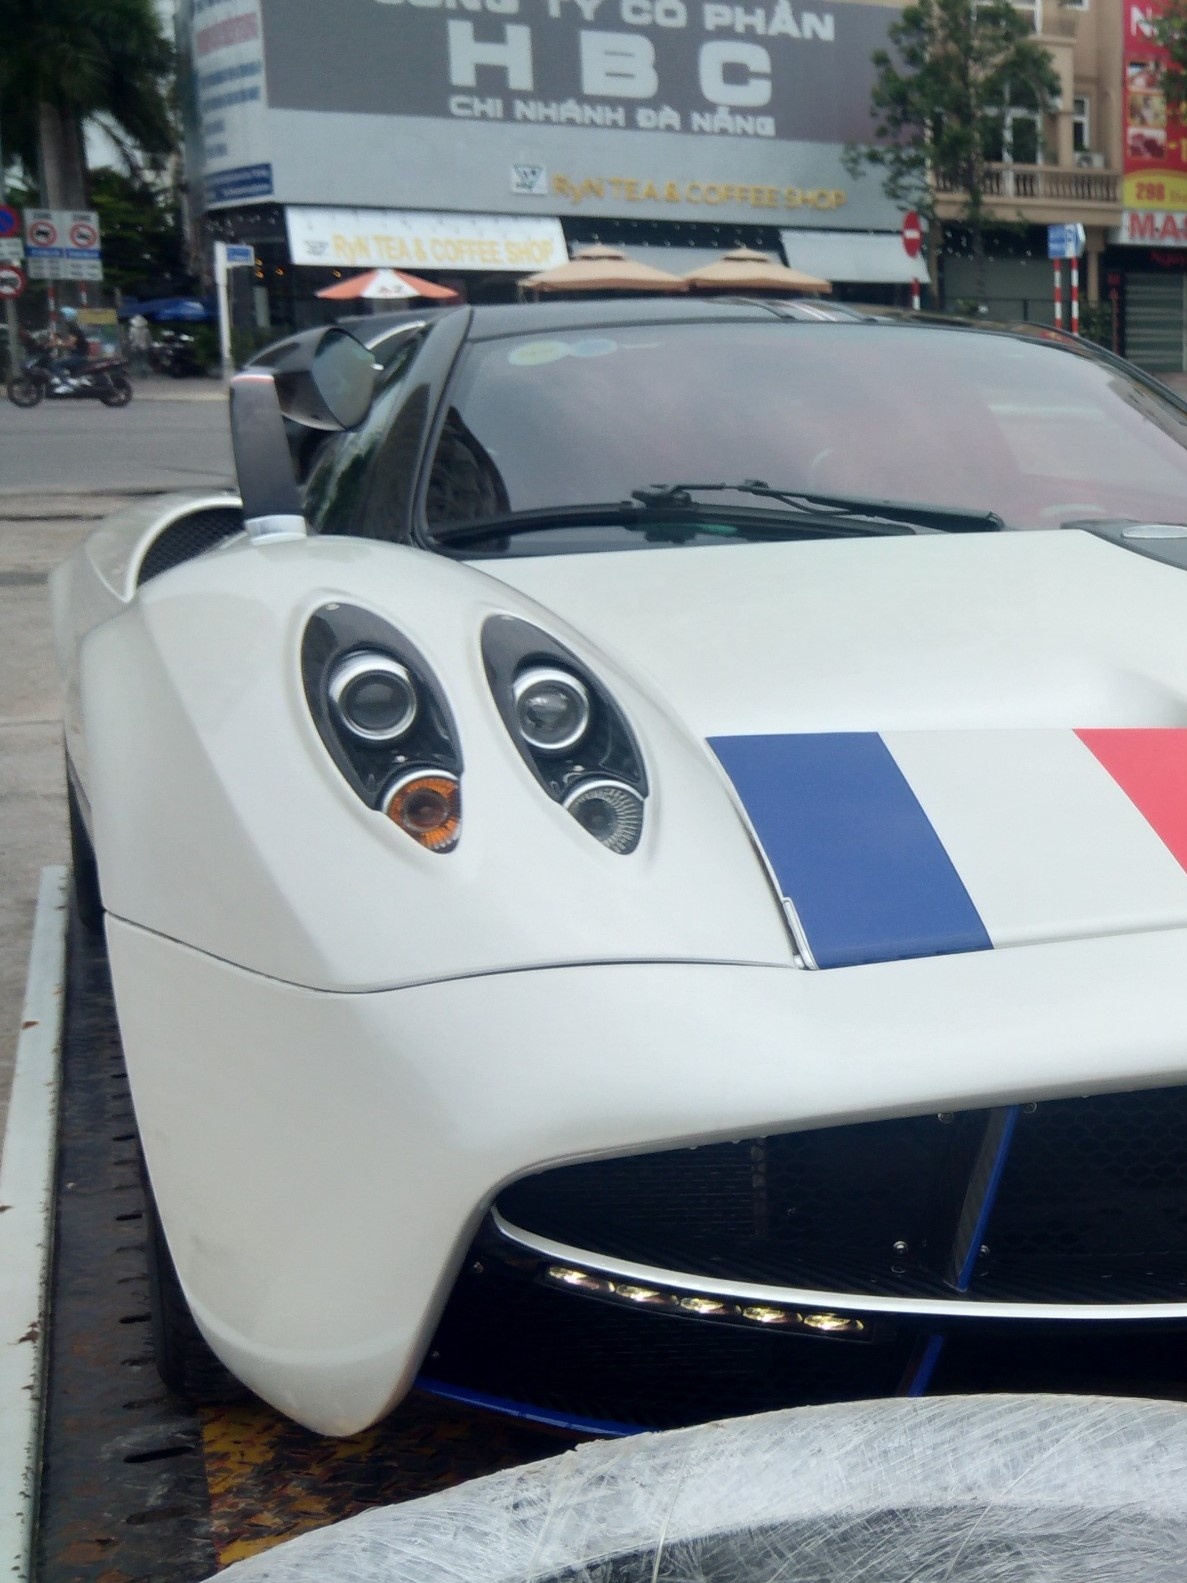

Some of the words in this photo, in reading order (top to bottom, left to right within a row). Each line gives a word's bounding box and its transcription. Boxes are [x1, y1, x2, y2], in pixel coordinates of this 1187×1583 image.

[449, 95, 504, 119] CHI
[607, 176, 658, 202] TEA
[664, 180, 680, 203] &
[685, 182, 780, 208] COFFEE
[783, 187, 848, 211] SHOP
[372, 234, 411, 261] TEA
[412, 236, 429, 262] &
[430, 237, 501, 264] COFFEE
[503, 239, 554, 266] SHOP
